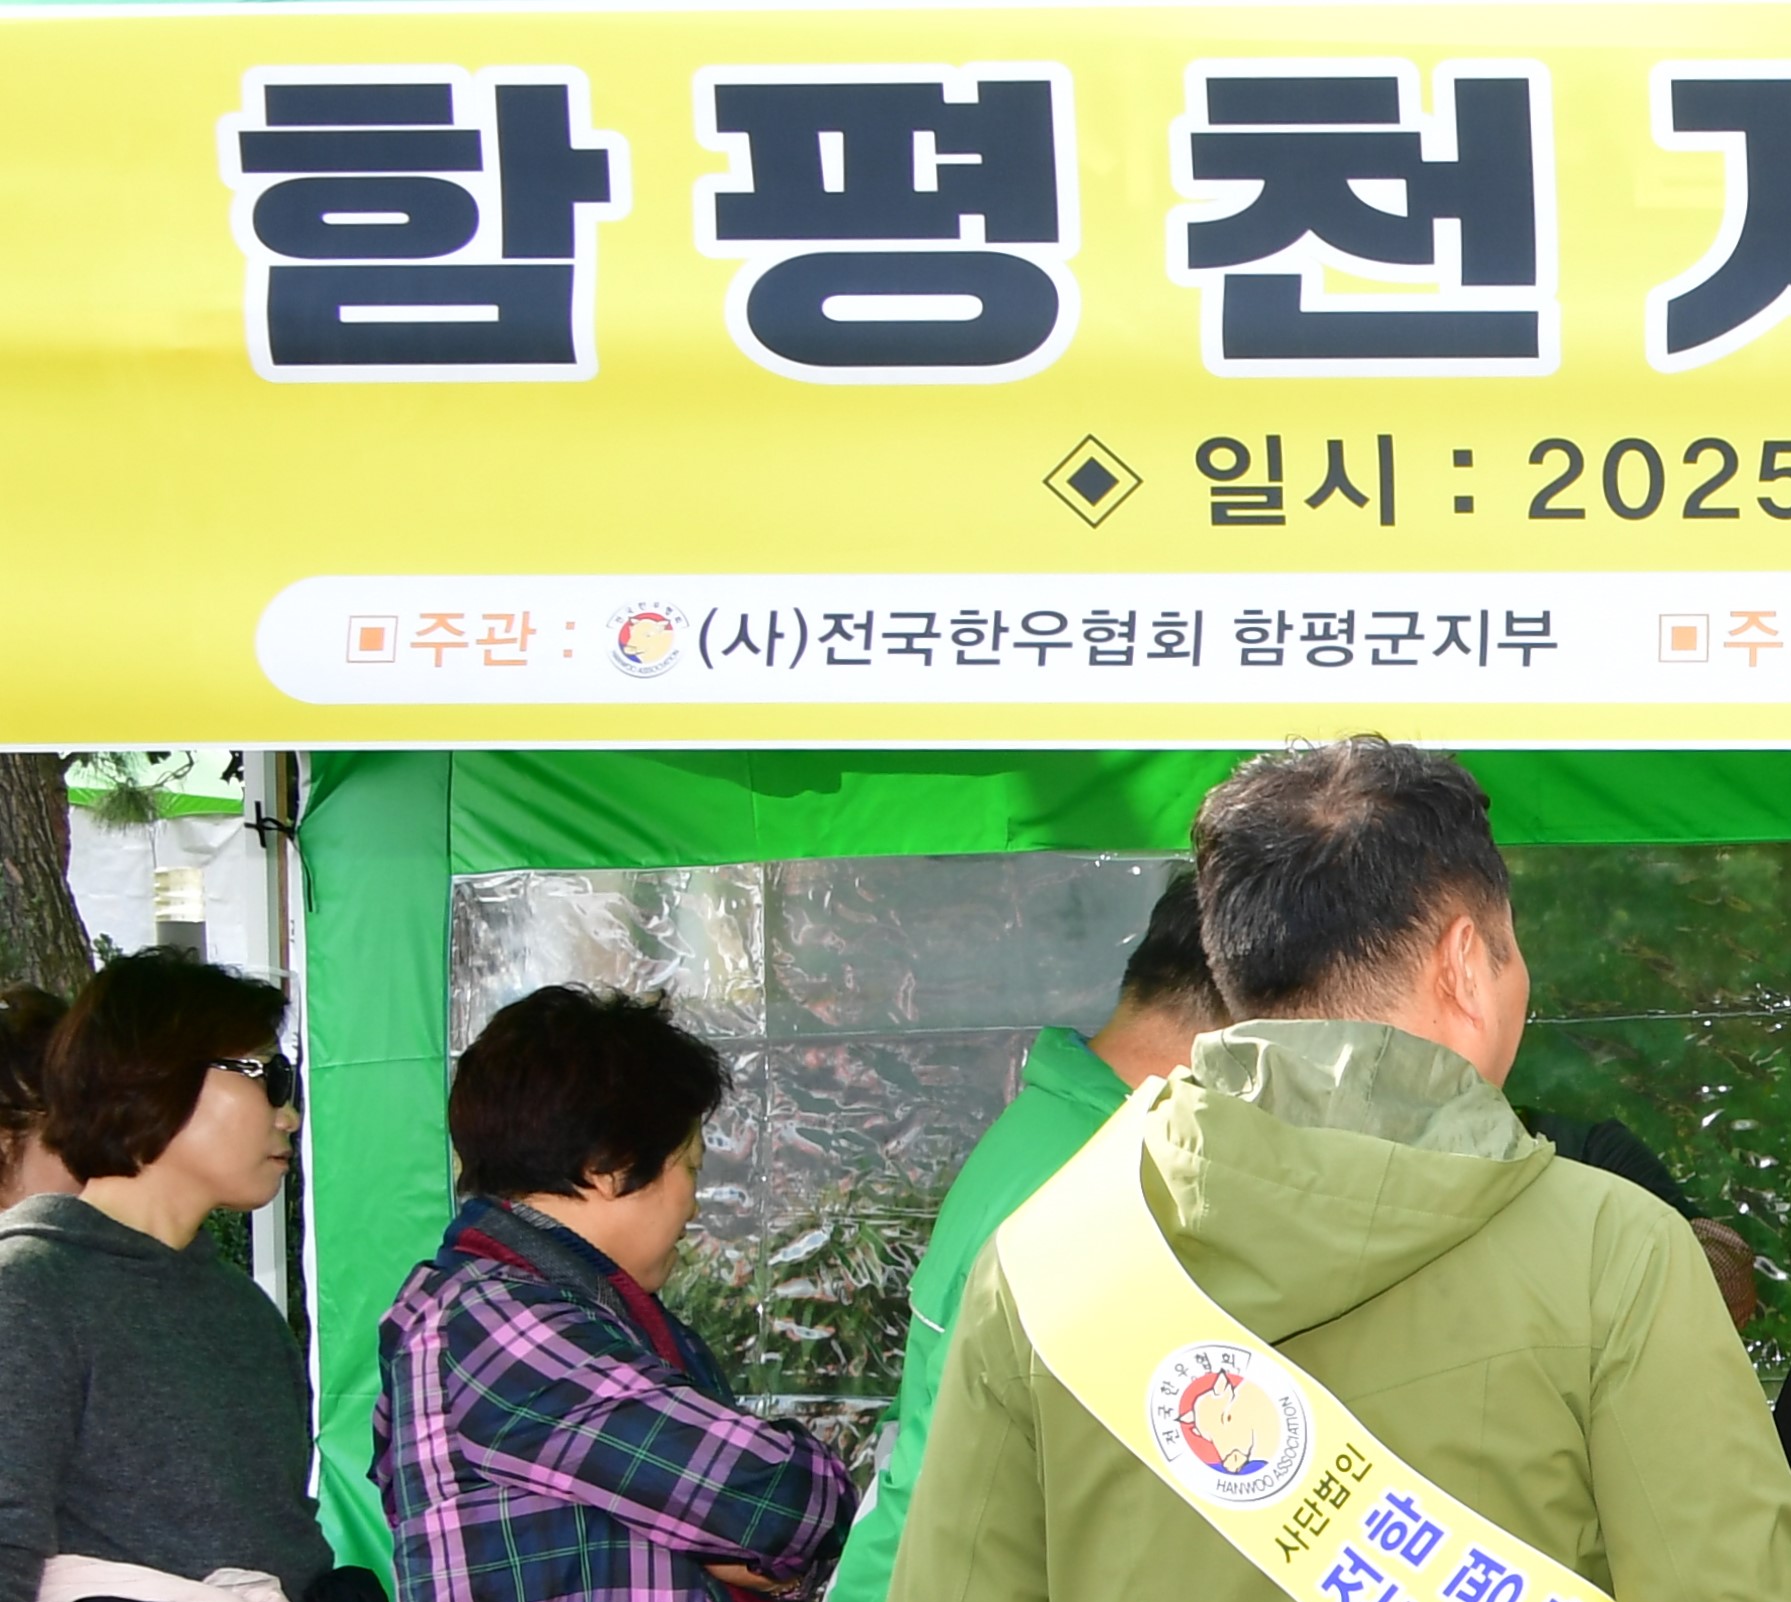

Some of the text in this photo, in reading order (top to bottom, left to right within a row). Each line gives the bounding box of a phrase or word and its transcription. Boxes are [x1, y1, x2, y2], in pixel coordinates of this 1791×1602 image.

[1195, 433, 1395, 526] 일시
[410, 611, 537, 667] 주관
[699, 607, 1203, 669] (사)전국한우협회
[1234, 609, 1559, 667] 함평군지부
[1216, 1395, 1300, 1495] HANWOO ASSOCIATION
[1275, 1442, 1373, 1563] 사단법인
